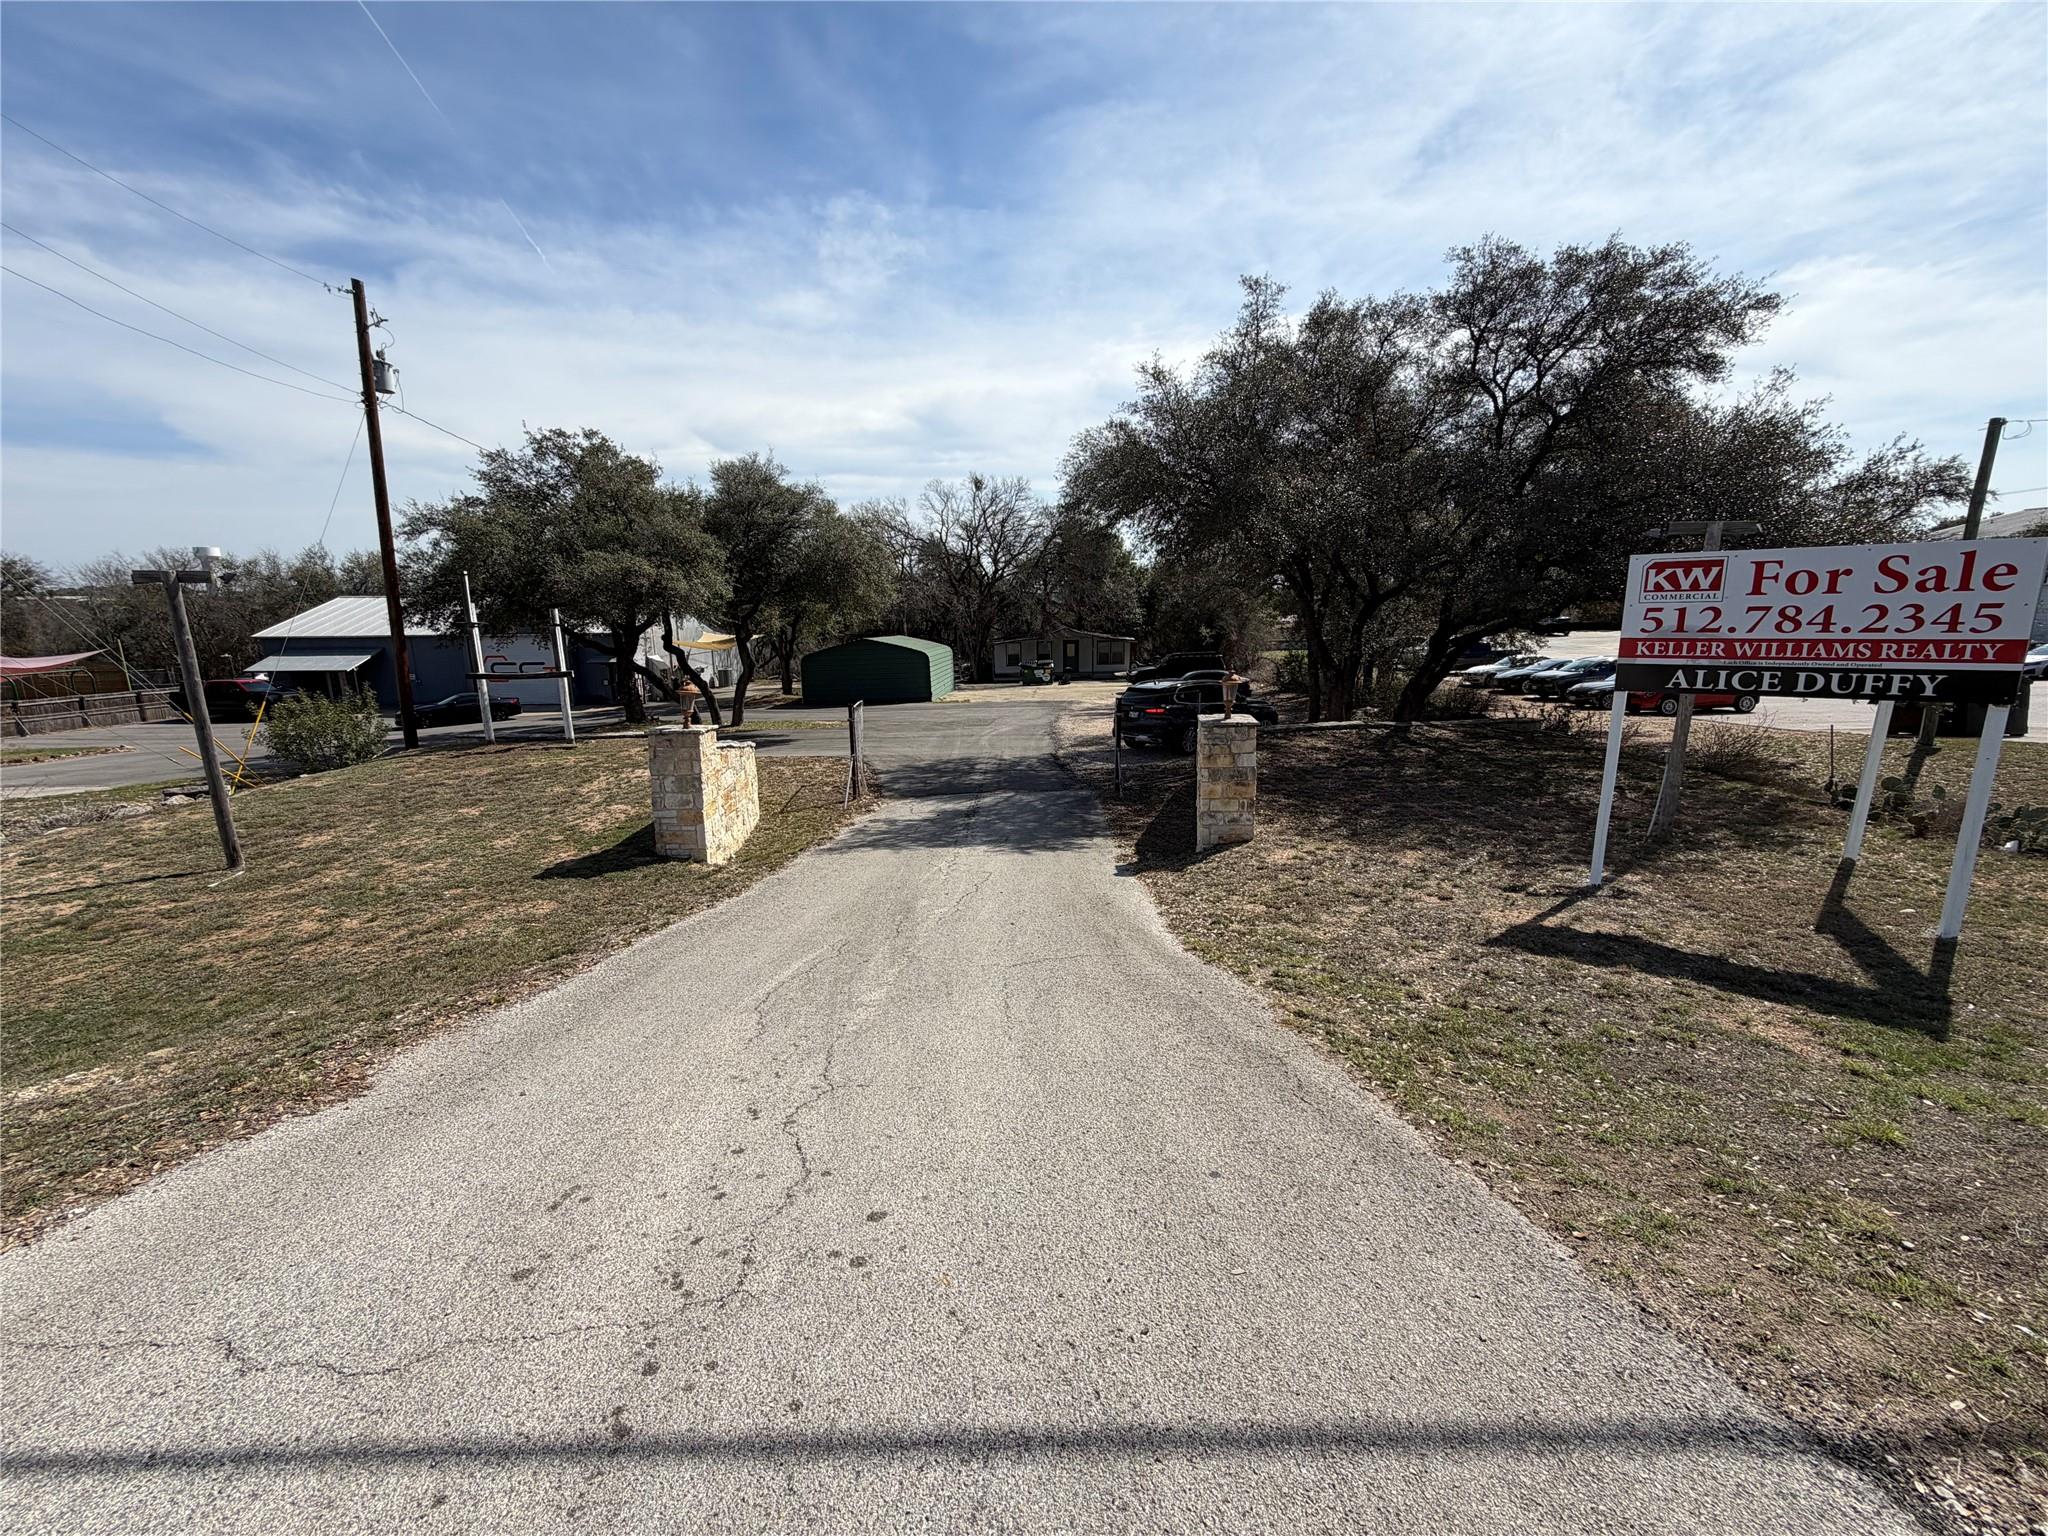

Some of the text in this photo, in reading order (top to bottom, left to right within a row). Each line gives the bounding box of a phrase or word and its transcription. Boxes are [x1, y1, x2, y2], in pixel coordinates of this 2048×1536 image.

[1647, 566, 1722, 591] KW
[1746, 550, 2019, 595] For Sale
[1643, 592, 1719, 601] COMMERCIAL
[1640, 603, 2005, 633] 512.784.2345
[1635, 641, 2004, 660] KELLER WILLIAMS REALTY
[1666, 669, 1947, 696] ALICE DUFFY
